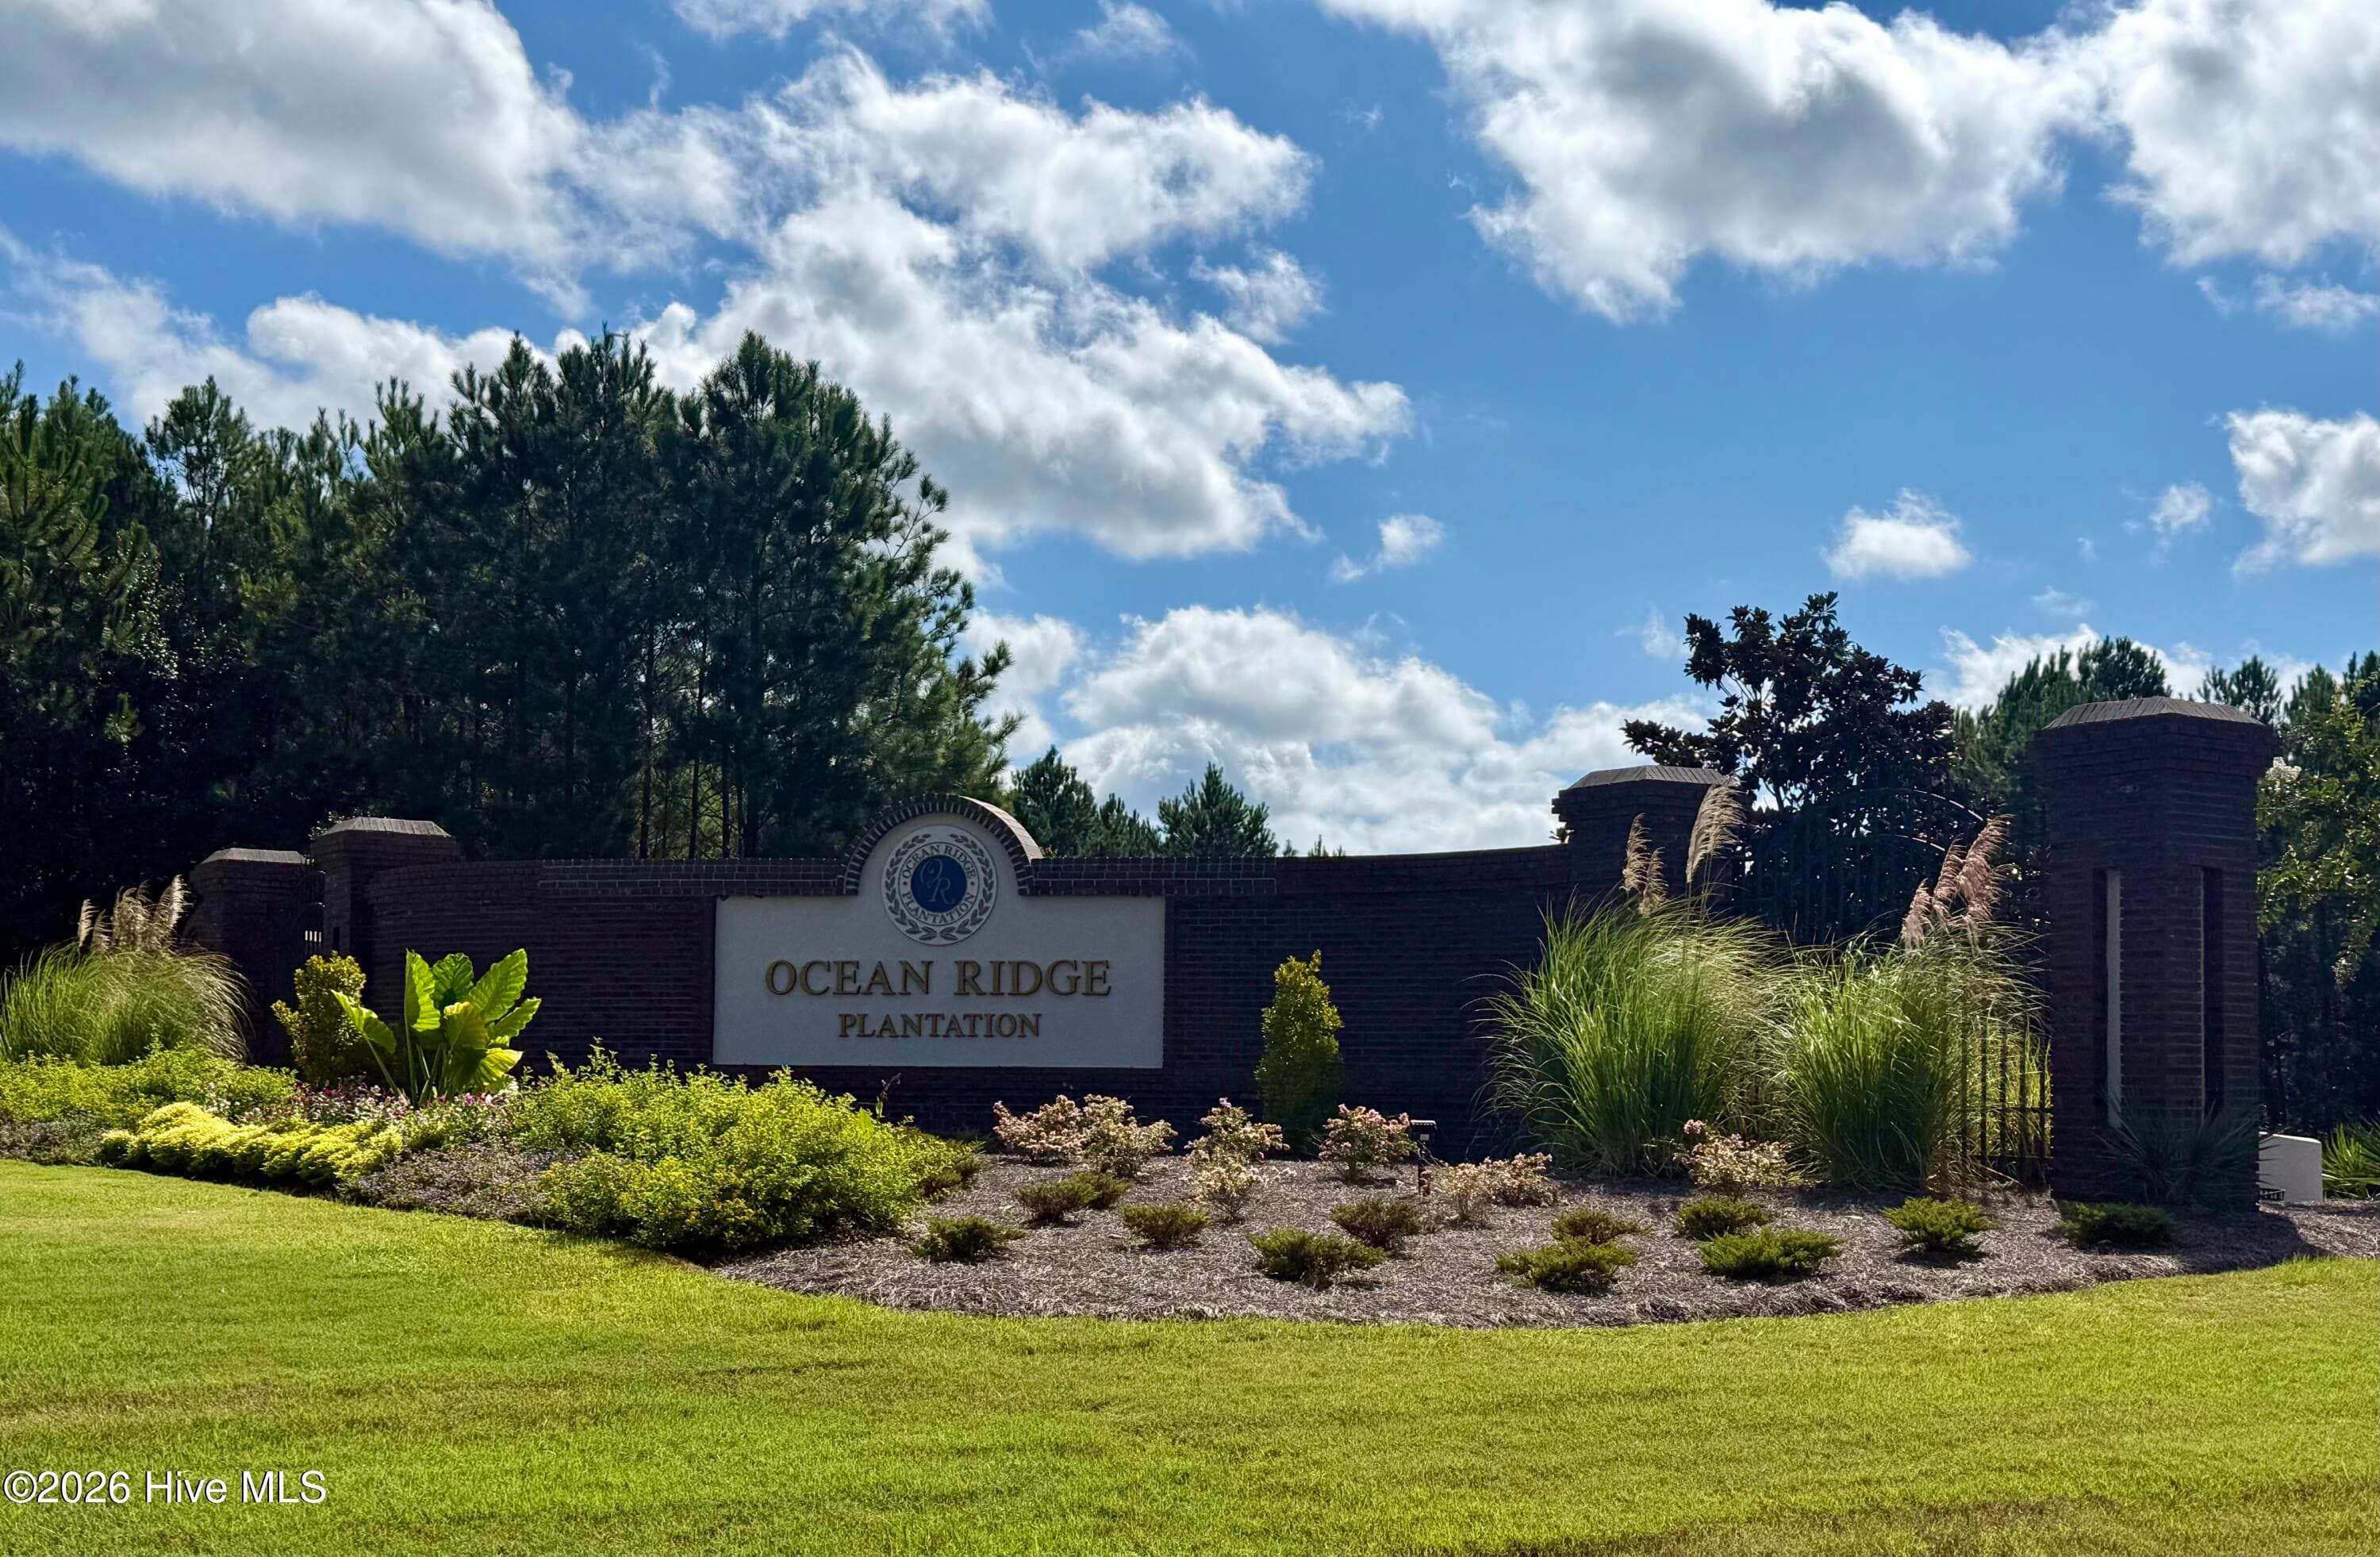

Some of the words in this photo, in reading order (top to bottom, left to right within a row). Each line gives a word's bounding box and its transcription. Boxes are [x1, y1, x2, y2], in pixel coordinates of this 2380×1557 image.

[902, 844, 940, 878] OCEAN
[943, 844, 977, 878] RIDGE
[902, 891, 976, 924] PLANTATION
[765, 959, 933, 996] OCEAN
[954, 959, 1111, 996] RIDGE
[838, 1013, 1042, 1038] PLANTATION
